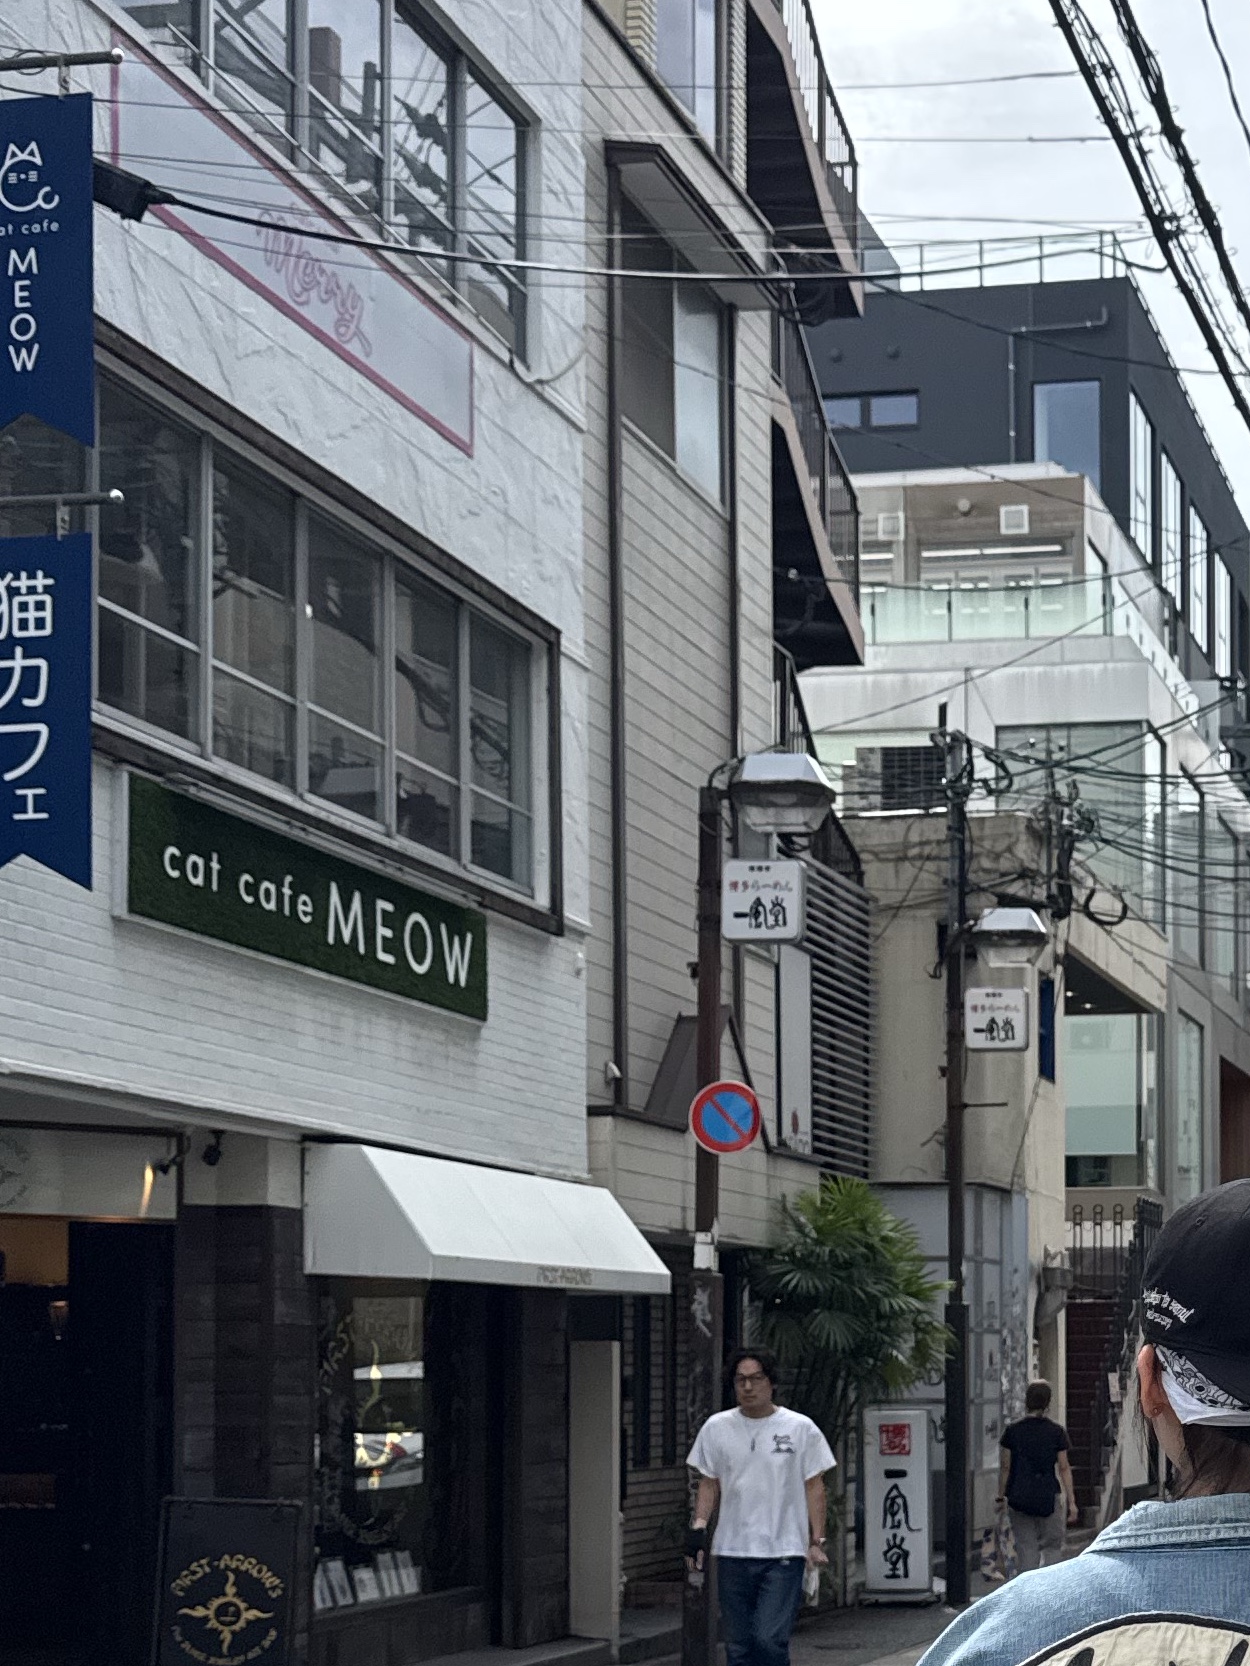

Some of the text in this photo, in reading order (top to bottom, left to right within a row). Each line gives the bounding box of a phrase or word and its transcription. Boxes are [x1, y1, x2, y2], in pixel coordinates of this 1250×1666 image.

[21, 219, 60, 235] cafe
[8, 247, 40, 372] MEOW
[0, 569, 55, 820] 猫カフェ
[163, 846, 474, 988] cat cafe MEOW
[882, 1468, 922, 1579] 一風堂
